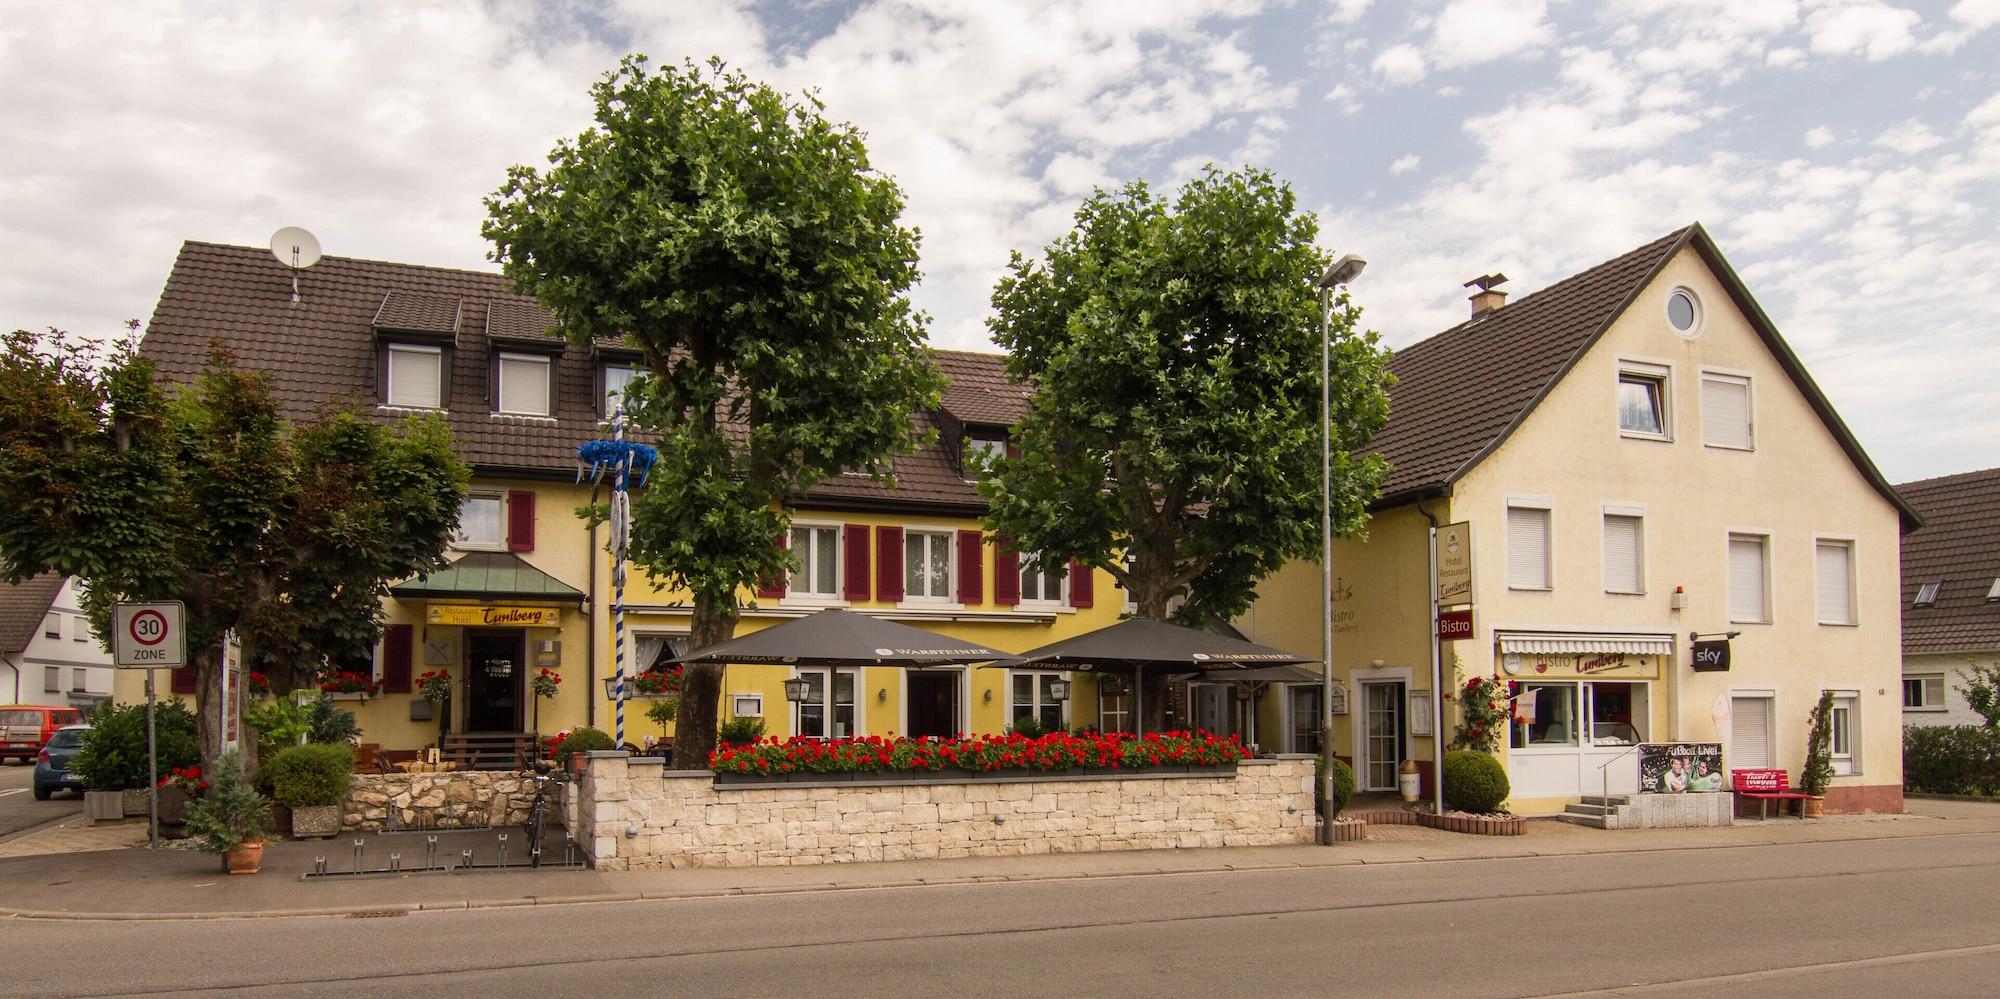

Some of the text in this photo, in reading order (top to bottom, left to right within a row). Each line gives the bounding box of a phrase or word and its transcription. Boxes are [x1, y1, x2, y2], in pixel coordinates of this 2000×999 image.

[1446, 556, 1462, 567] Hotel
[1439, 567, 1469, 578] Restaurant
[445, 607, 479, 615] Restaurant
[481, 607, 542, 624] Tuniberg
[452, 616, 471, 624] Hotel
[138, 619, 159, 635] 30
[1441, 620, 1470, 633] Bistro
[134, 650, 166, 660] ZONE
[895, 648, 991, 656] WARSTEINER
[1209, 653, 1296, 661] WARSTEINER
[1696, 647, 1721, 665] sky
[1536, 652, 1571, 668] Bistro
